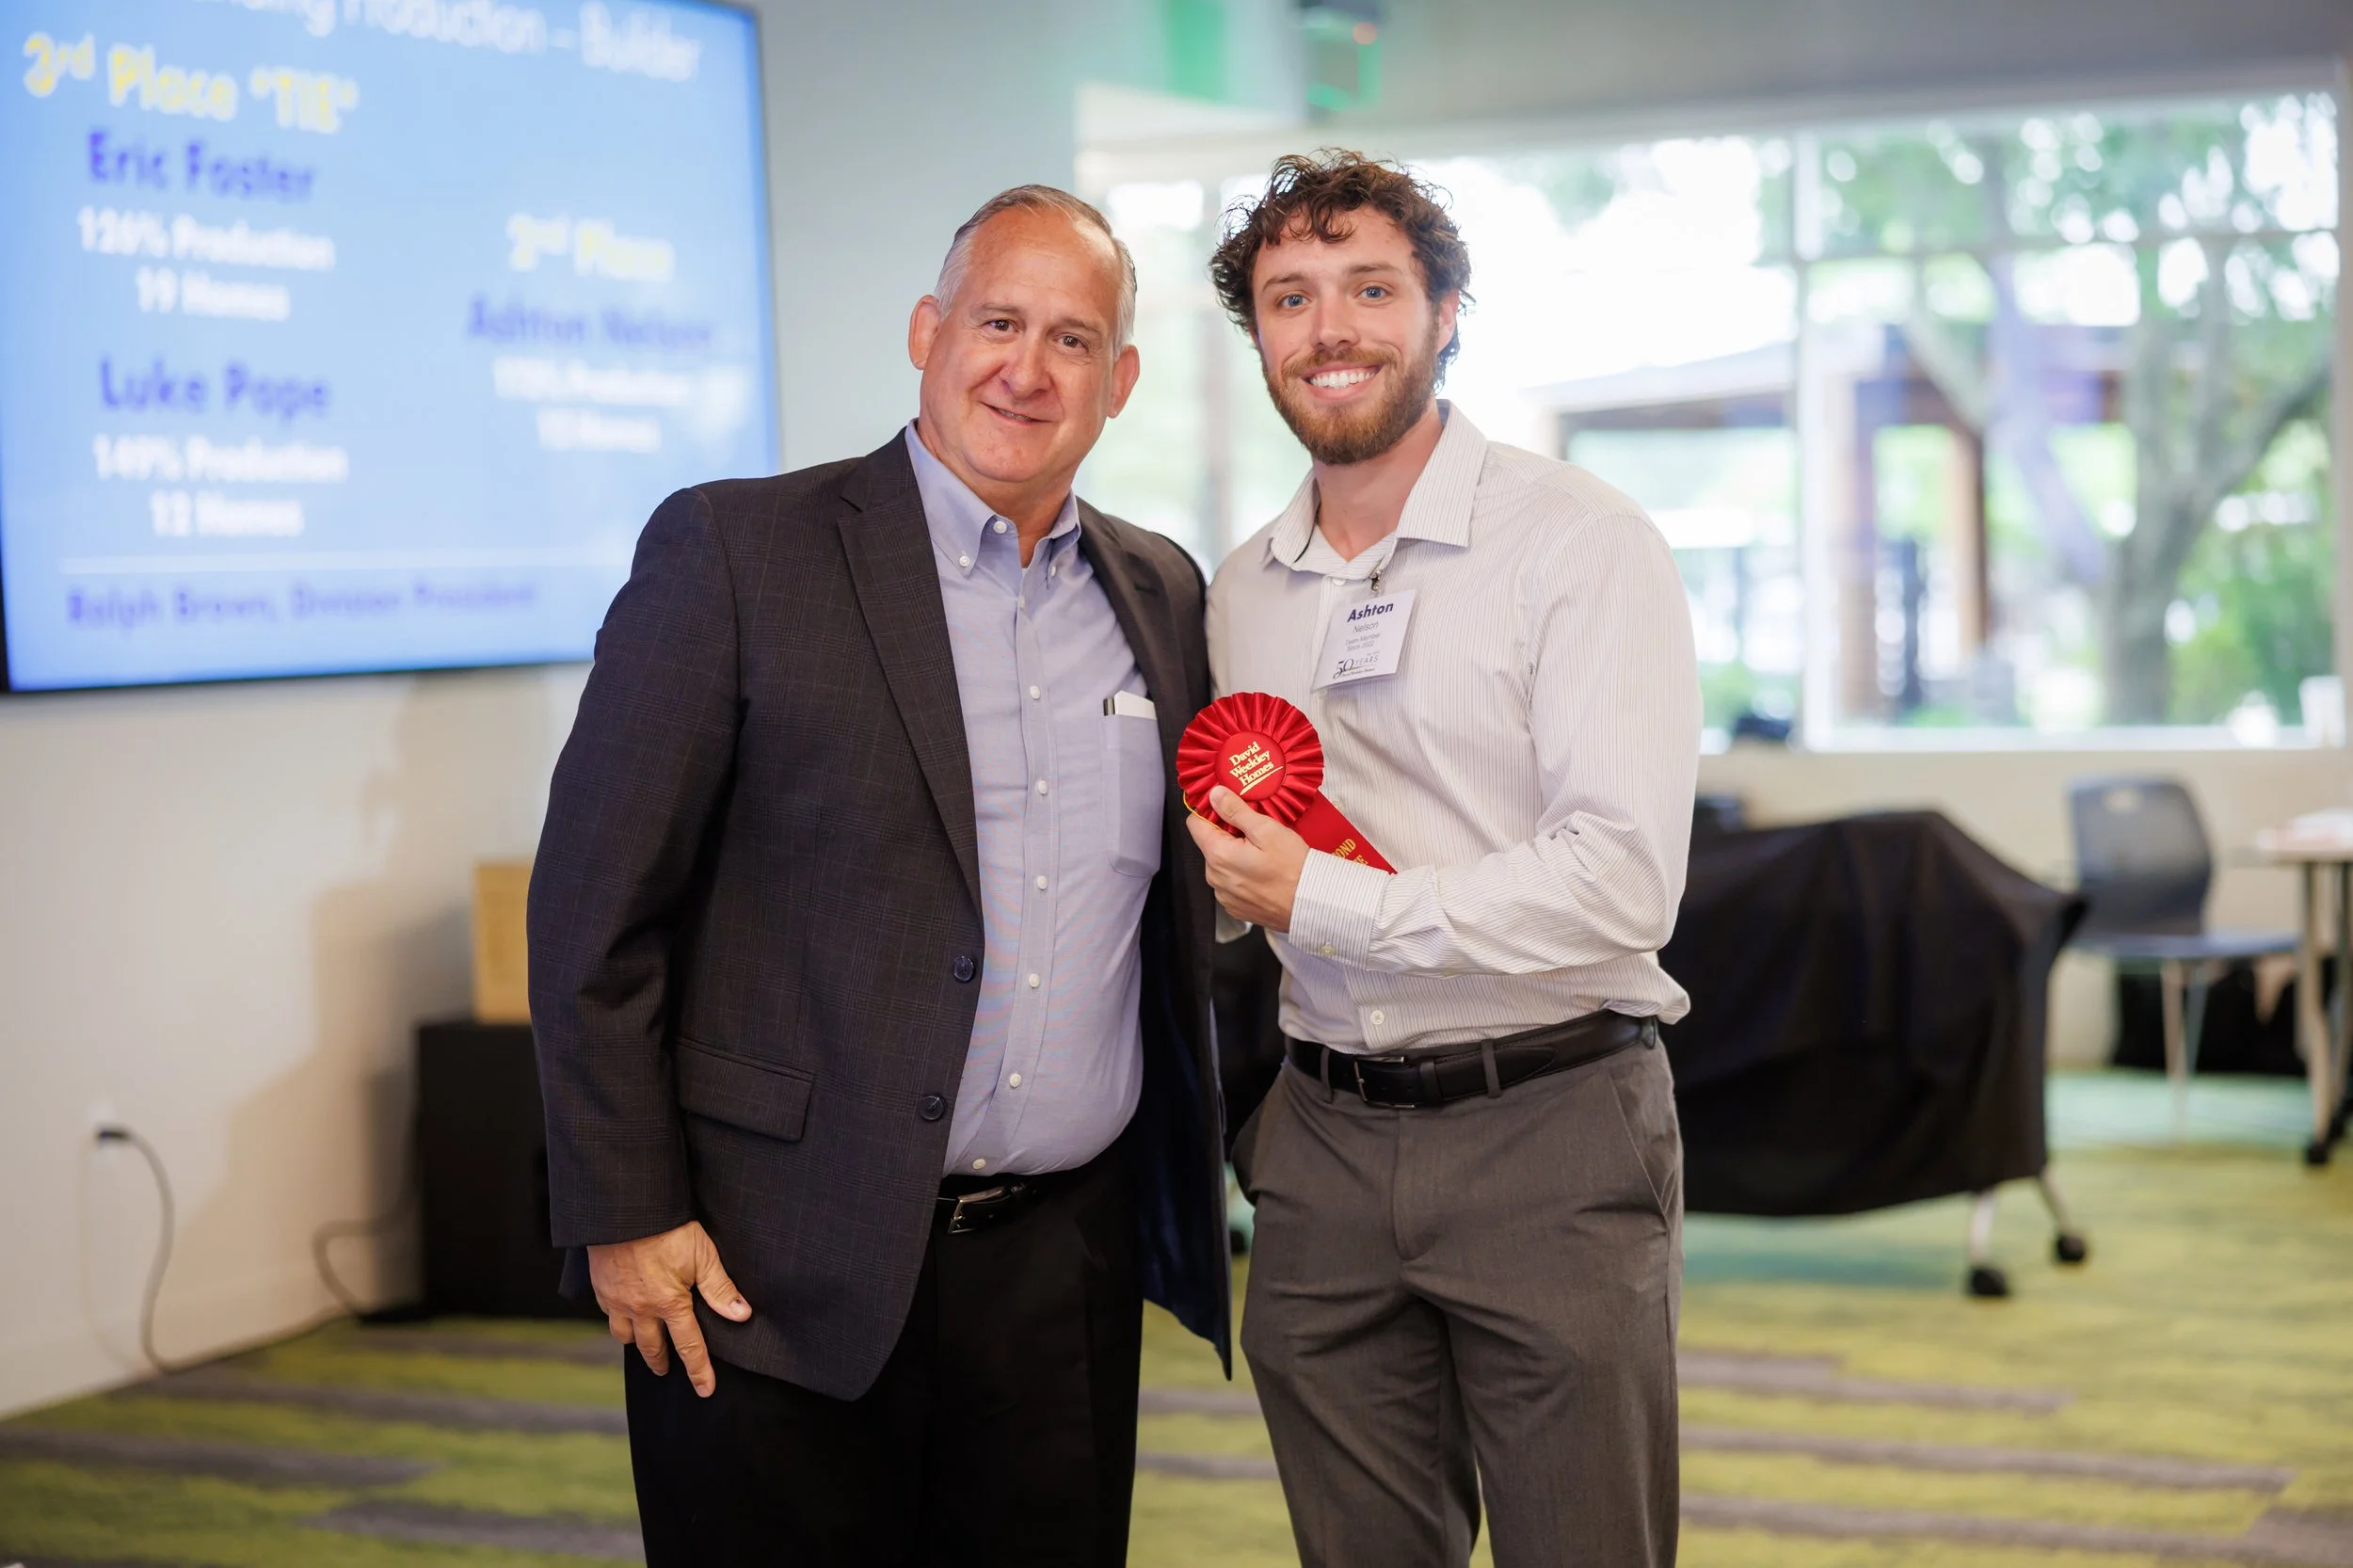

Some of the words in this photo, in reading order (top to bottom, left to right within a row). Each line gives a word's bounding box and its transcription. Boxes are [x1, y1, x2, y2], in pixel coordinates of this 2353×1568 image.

[24, 32, 96, 97] 3rd
[107, 43, 239, 121] Place
[87, 127, 169, 188] Eric
[184, 140, 316, 202] Foster
[99, 354, 209, 415] Luke
[221, 357, 332, 430] Pope
[1347, 602, 1394, 623] Ashton
[1353, 621, 1379, 632] Nelson
[1355, 655, 1379, 666] YEARS
[1228, 741, 1261, 767] David
[1229, 750, 1271, 778] Weekley
[1239, 761, 1274, 787] Homes
[1332, 839, 1356, 858] OND
